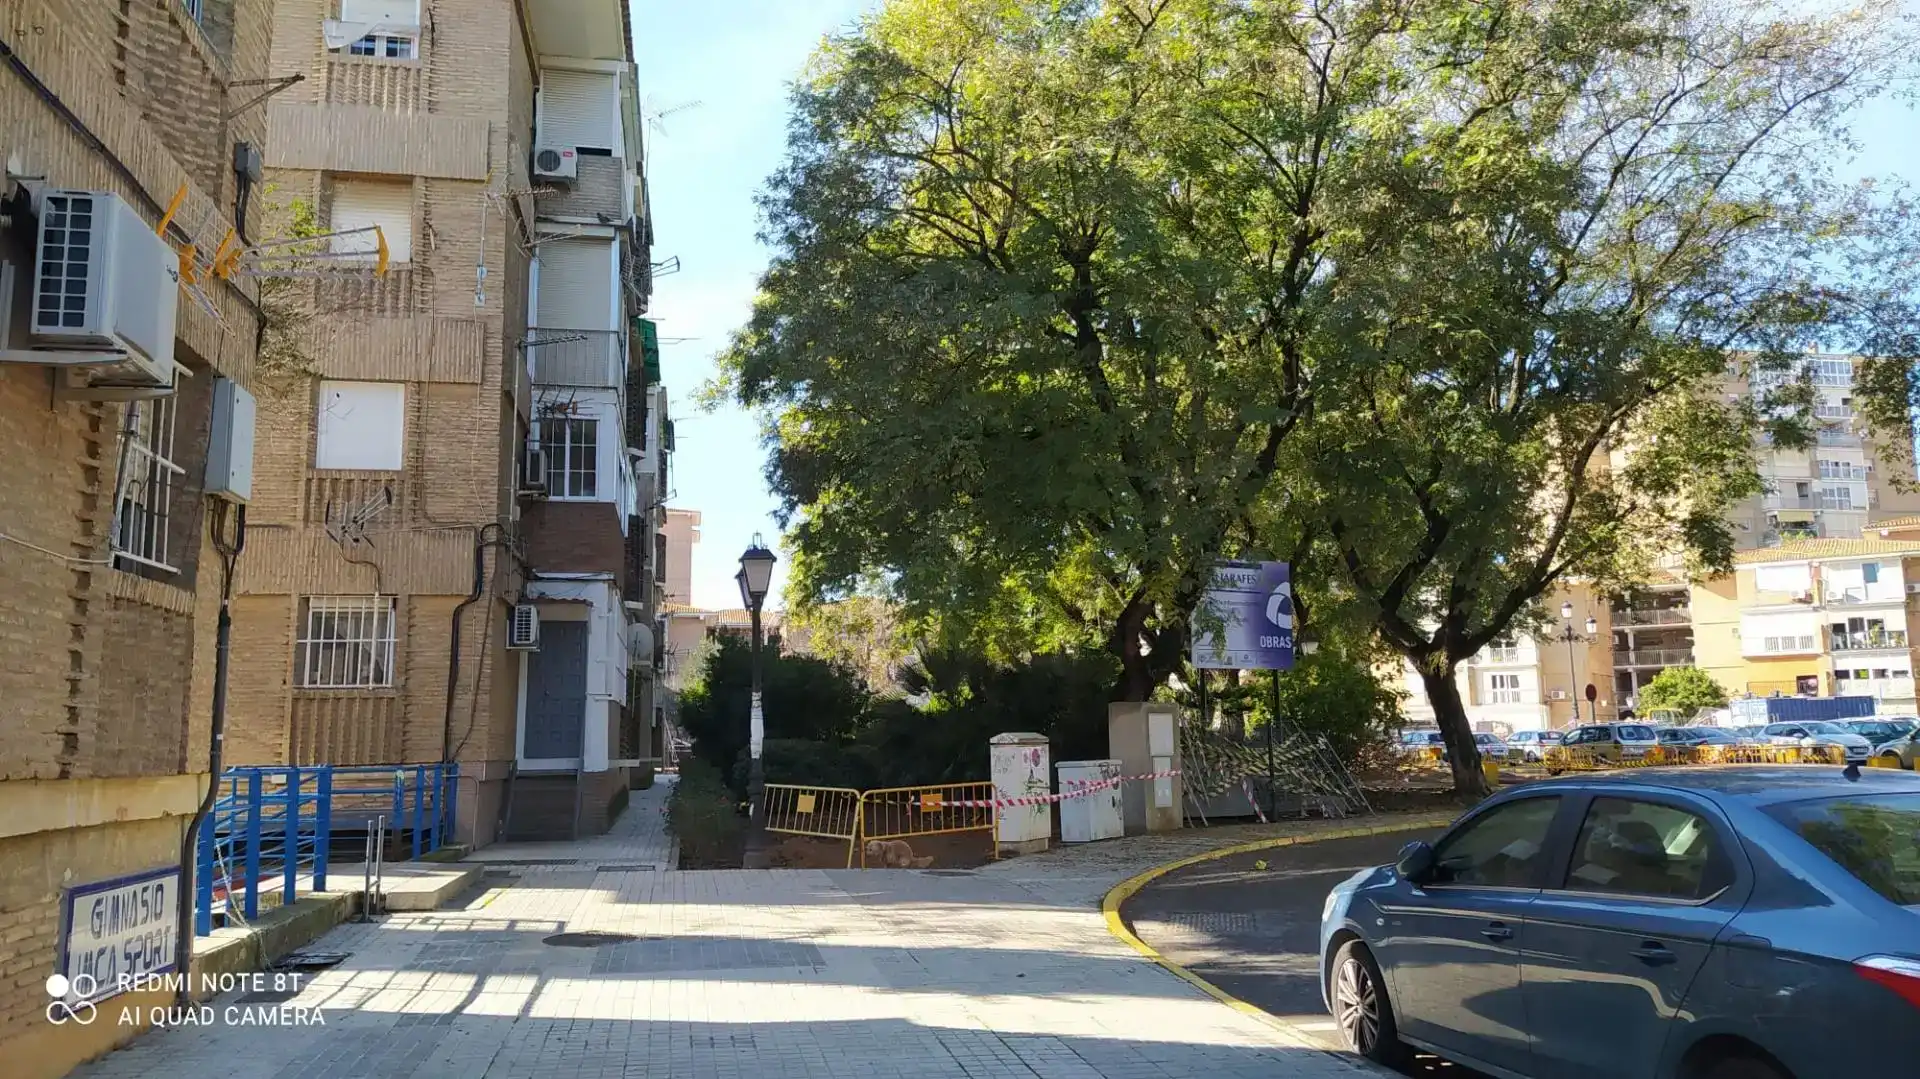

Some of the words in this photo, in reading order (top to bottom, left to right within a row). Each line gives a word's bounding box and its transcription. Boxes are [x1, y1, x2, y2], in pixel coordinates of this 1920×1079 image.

[1260, 636, 1292, 649] OBRAS
[91, 882, 165, 939] GIMNASIO
[123, 925, 172, 979] SPORT
